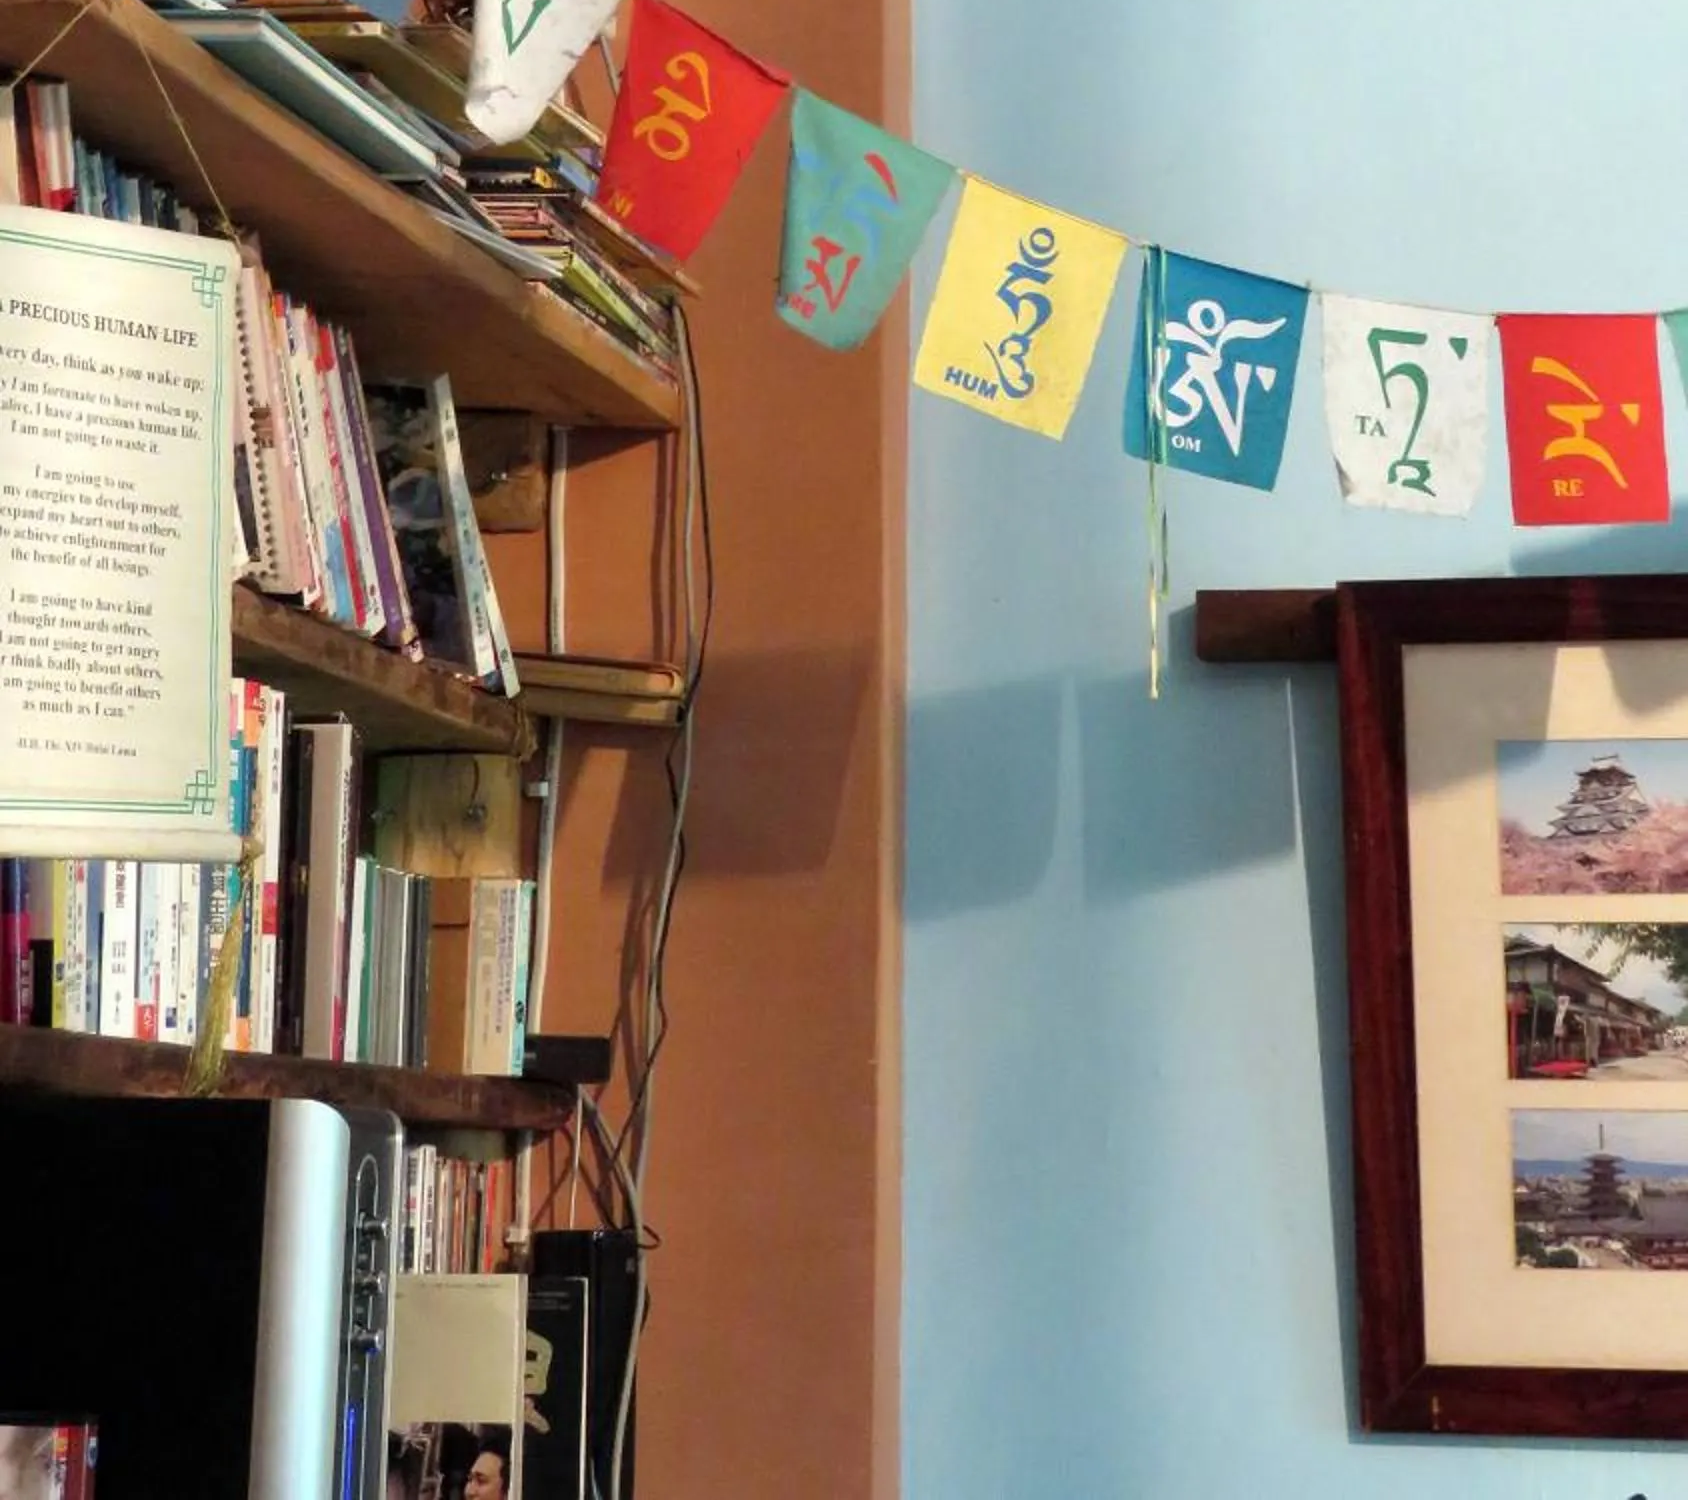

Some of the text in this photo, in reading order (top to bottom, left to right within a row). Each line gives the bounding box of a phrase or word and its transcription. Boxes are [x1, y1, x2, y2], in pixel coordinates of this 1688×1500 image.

[10, 299, 91, 329] PRECIOUS
[94, 314, 158, 341] HUMAN
[163, 327, 198, 349] LIFE
[63, 354, 97, 373] think
[100, 363, 115, 375] as
[118, 365, 143, 382] you
[147, 369, 182, 387] wake
[19, 381, 39, 394] am
[42, 382, 97, 404] fortunate
[99, 393, 111, 406] to
[943, 365, 998, 402] HUM
[36, 401, 41, 416] I
[45, 403, 72, 421] have
[75, 410, 83, 422] a
[86, 413, 135, 431] precious
[138, 417, 178, 438] human
[1355, 414, 1388, 438] TA
[11, 419, 17, 434] I
[20, 424, 39, 436] am
[42, 427, 61, 440] not
[65, 430, 98, 449] going
[101, 435, 113, 447] to
[1171, 435, 1202, 454] OM
[35, 463, 41, 479] I
[44, 470, 62, 481] am
[65, 471, 101, 488] going
[1553, 478, 1584, 498] RE
[3, 485, 20, 500] my
[25, 488, 75, 505] energies
[79, 493, 92, 506] to
[95, 493, 139, 516] develop
[48, 511, 65, 528] my
[69, 510, 103, 528] heart
[105, 518, 125, 532] out
[128, 520, 139, 533] to
[13, 525, 59, 544] achieve
[149, 541, 166, 558] for
[11, 546, 30, 562] the
[33, 548, 76, 566] benefit
[79, 554, 92, 568] of
[95, 555, 109, 571] all
[11, 586, 153, 617] I am going to have kind
[60, 616, 109, 633] towards
[7, 634, 25, 646] am
[29, 636, 49, 648] not
[53, 636, 88, 655] going
[91, 640, 103, 653] to
[105, 643, 123, 658] get
[127, 645, 160, 662] angry
[11, 652, 42, 669] think
[47, 654, 81, 677] badly
[87, 659, 121, 675] about
[3, 676, 23, 689] am
[25, 677, 61, 694] going
[64, 680, 77, 693] to
[80, 680, 123, 697] benefit
[22, 699, 36, 712] as
[39, 698, 73, 715] much
[77, 704, 91, 715] as
[95, 700, 100, 716] I
